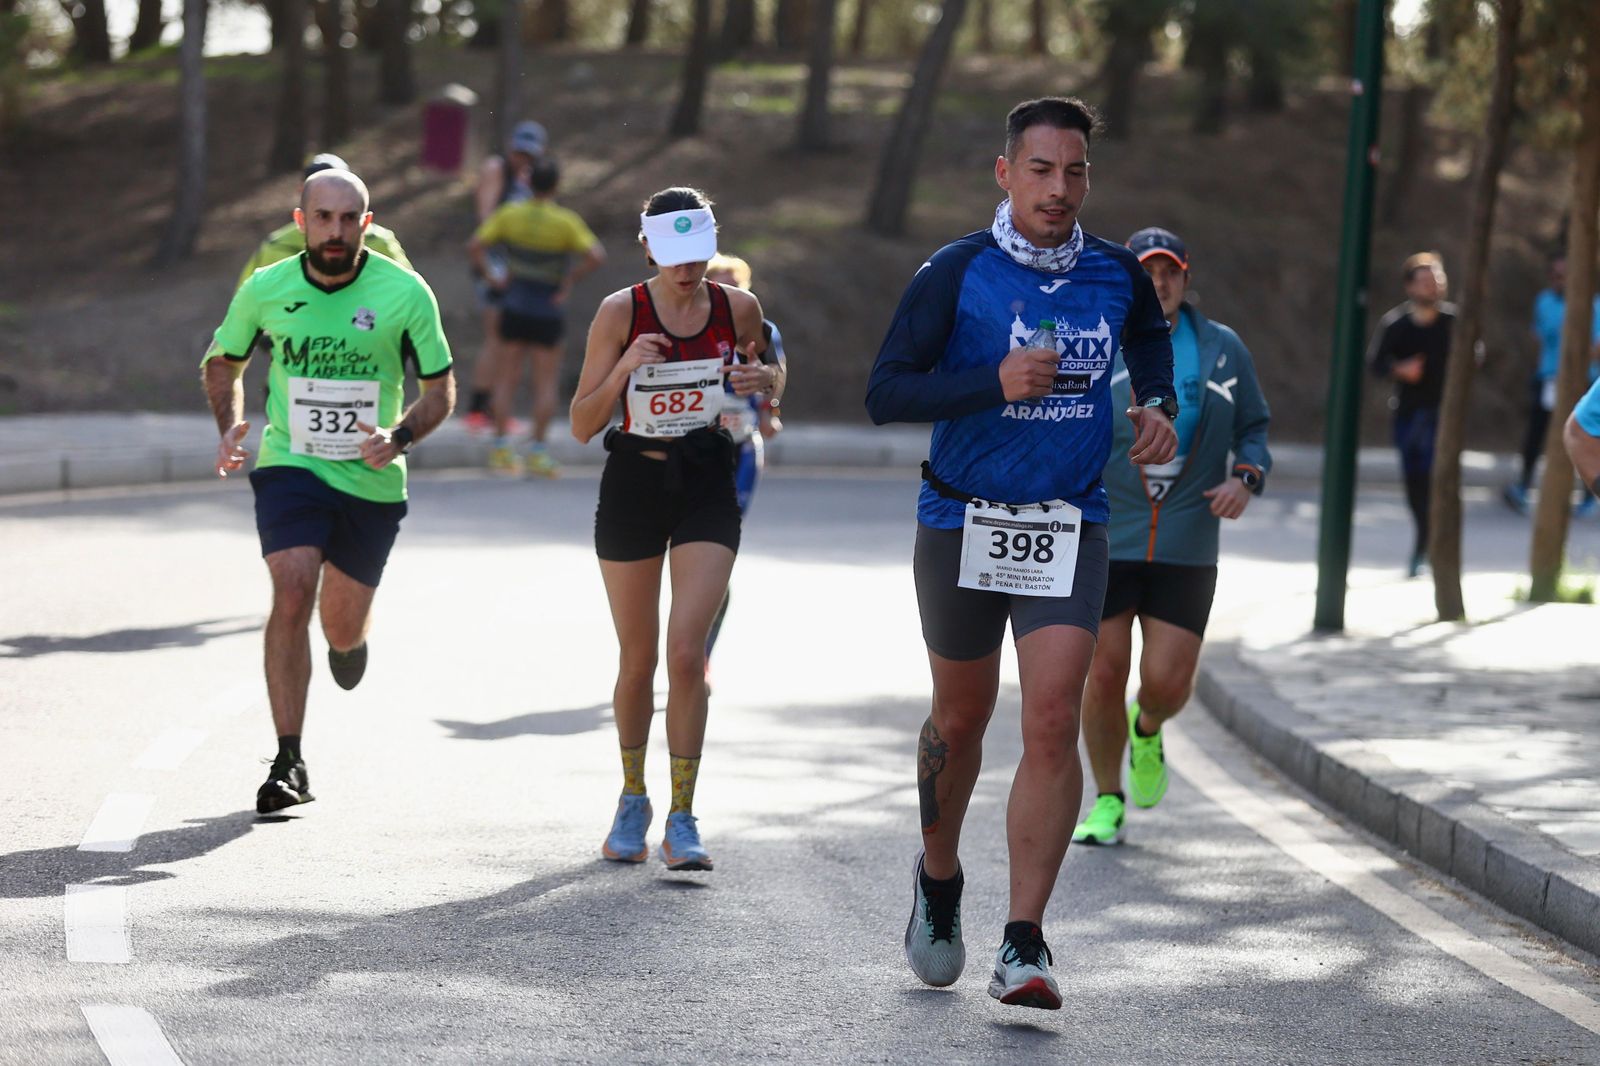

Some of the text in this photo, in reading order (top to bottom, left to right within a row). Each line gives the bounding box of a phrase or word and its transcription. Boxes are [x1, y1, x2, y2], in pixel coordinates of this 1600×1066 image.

[1062, 362, 1107, 370] POPULAR
[1051, 380, 1088, 390] ixaBank
[650, 390, 704, 415] 682
[308, 409, 358, 434] 332
[988, 530, 1055, 564] 398
[1007, 573, 1020, 581] MINI
[1022, 574, 1055, 583] MARATÓN
[995, 579, 1013, 588] PEÑA
[1025, 582, 1051, 590] BASTÓN
